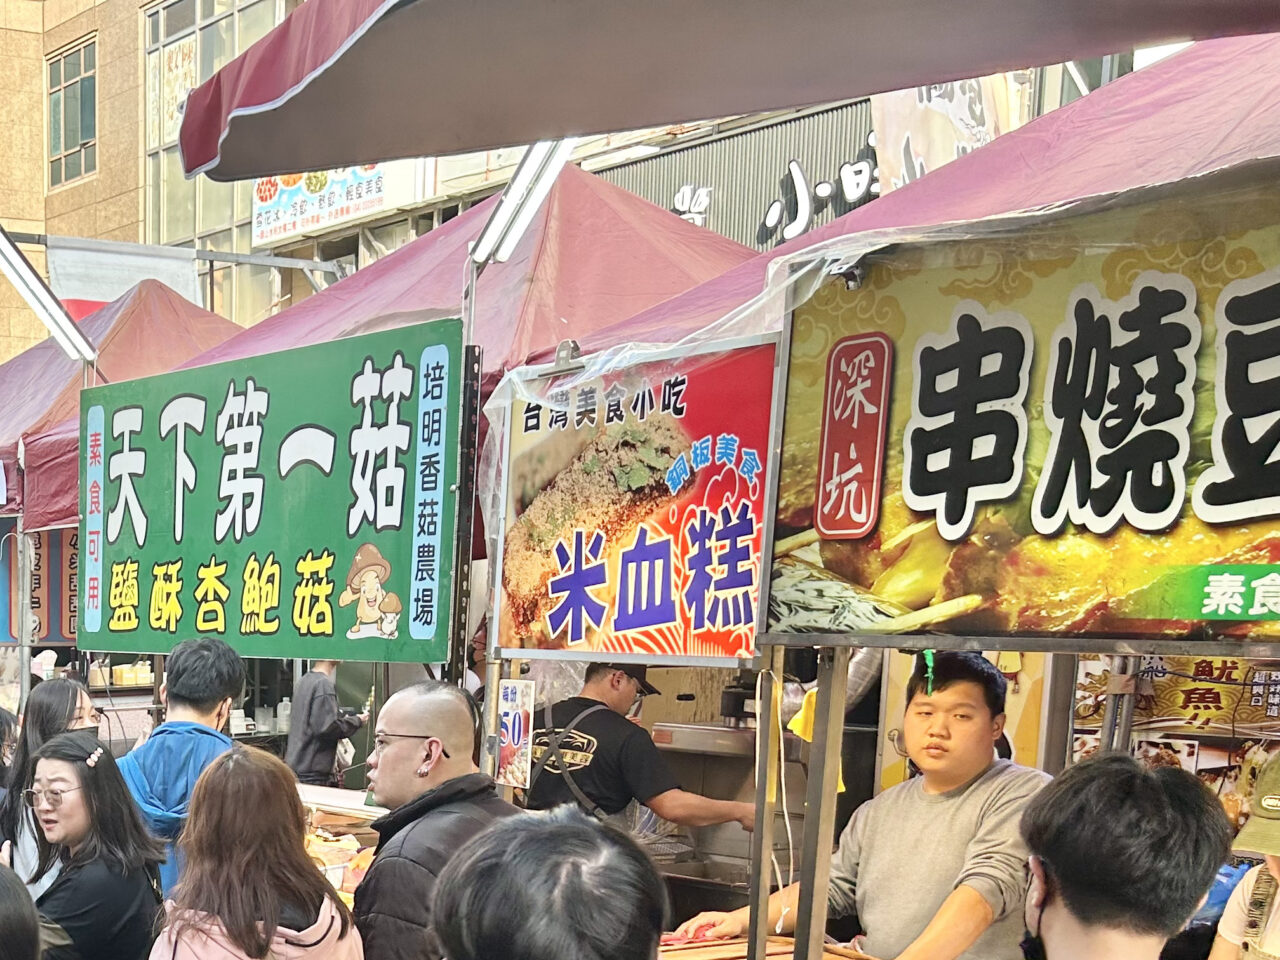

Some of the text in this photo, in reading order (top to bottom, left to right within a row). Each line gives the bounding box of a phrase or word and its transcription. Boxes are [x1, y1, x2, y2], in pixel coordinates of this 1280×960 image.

[106, 350, 416, 550] 天下第一菇
[522, 374, 688, 434] 台灣美食小吃
[665, 434, 763, 494] 銅板美食
[822, 349, 878, 523] 深坑
[88, 431, 102, 612] 素食可用
[411, 361, 448, 627] 培明香菇農場
[108, 549, 336, 638] 鹽酥杏鮑菇
[546, 500, 756, 645] 米血糕
[1180, 659, 1241, 712] 魷魚
